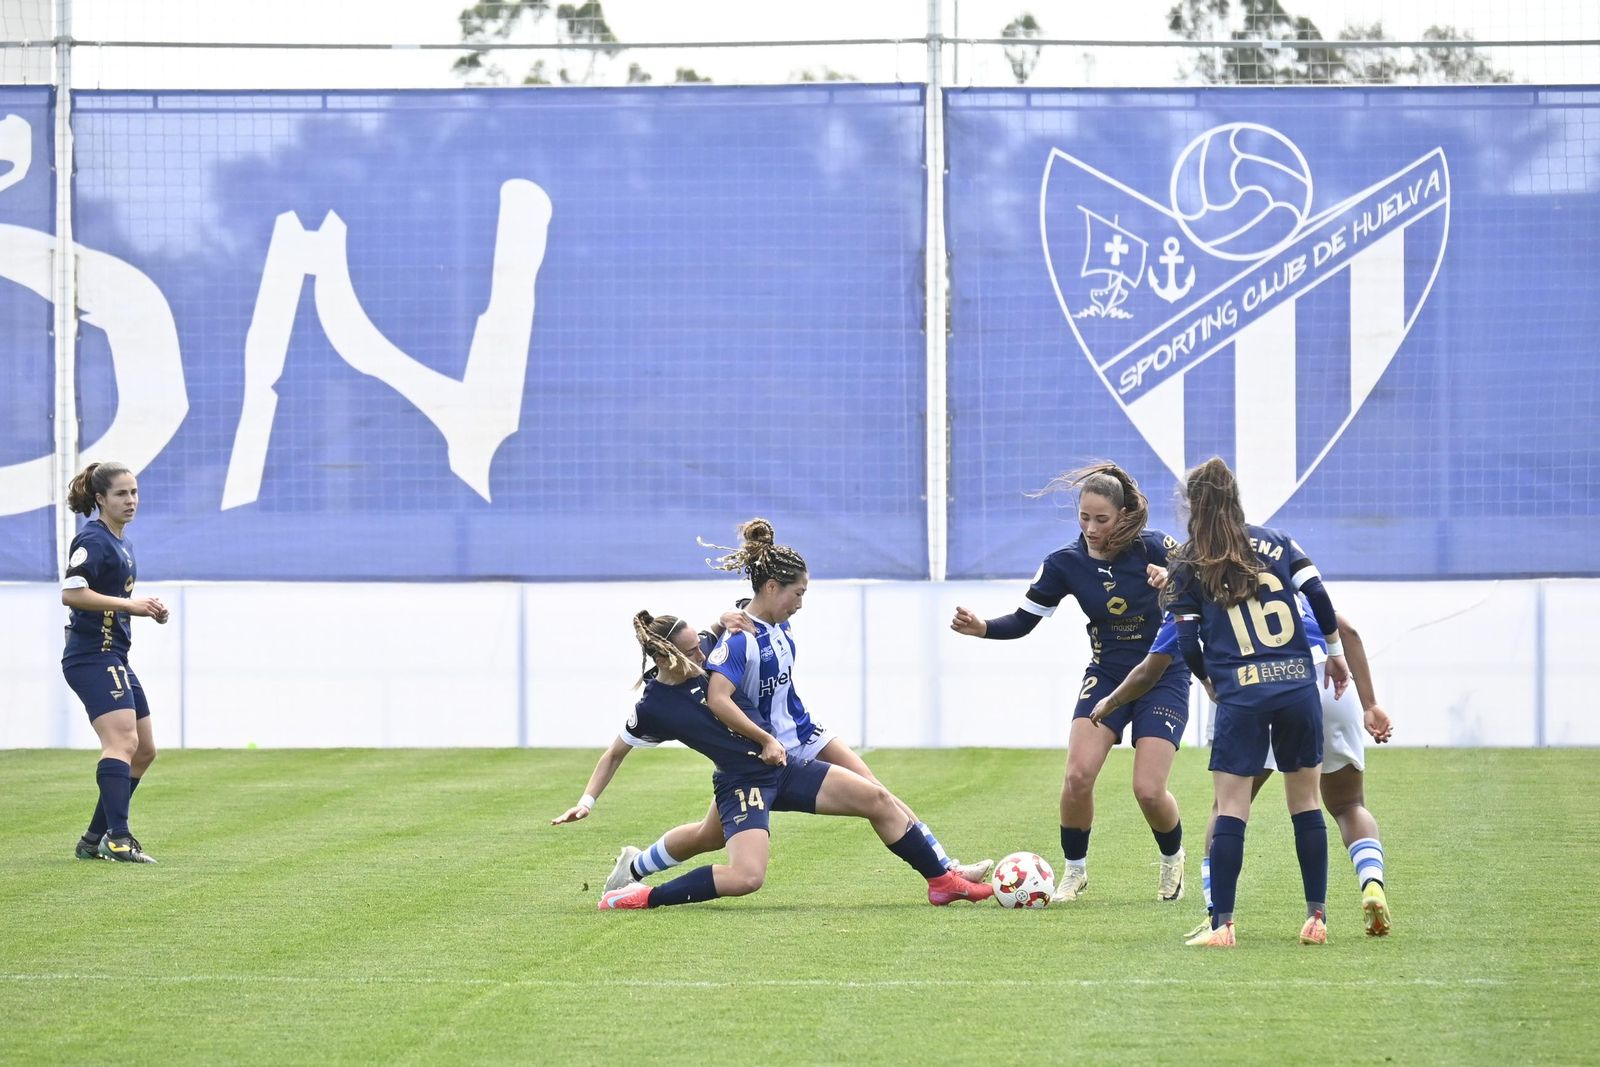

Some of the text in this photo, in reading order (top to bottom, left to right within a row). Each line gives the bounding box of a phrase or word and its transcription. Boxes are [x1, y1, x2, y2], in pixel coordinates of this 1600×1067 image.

[1117, 168, 1441, 395] SPORTING CLUB DE HUELVA
[1225, 571, 1296, 657] 16
[1261, 663, 1305, 678] ELEYCO
[734, 786, 765, 813] 14
